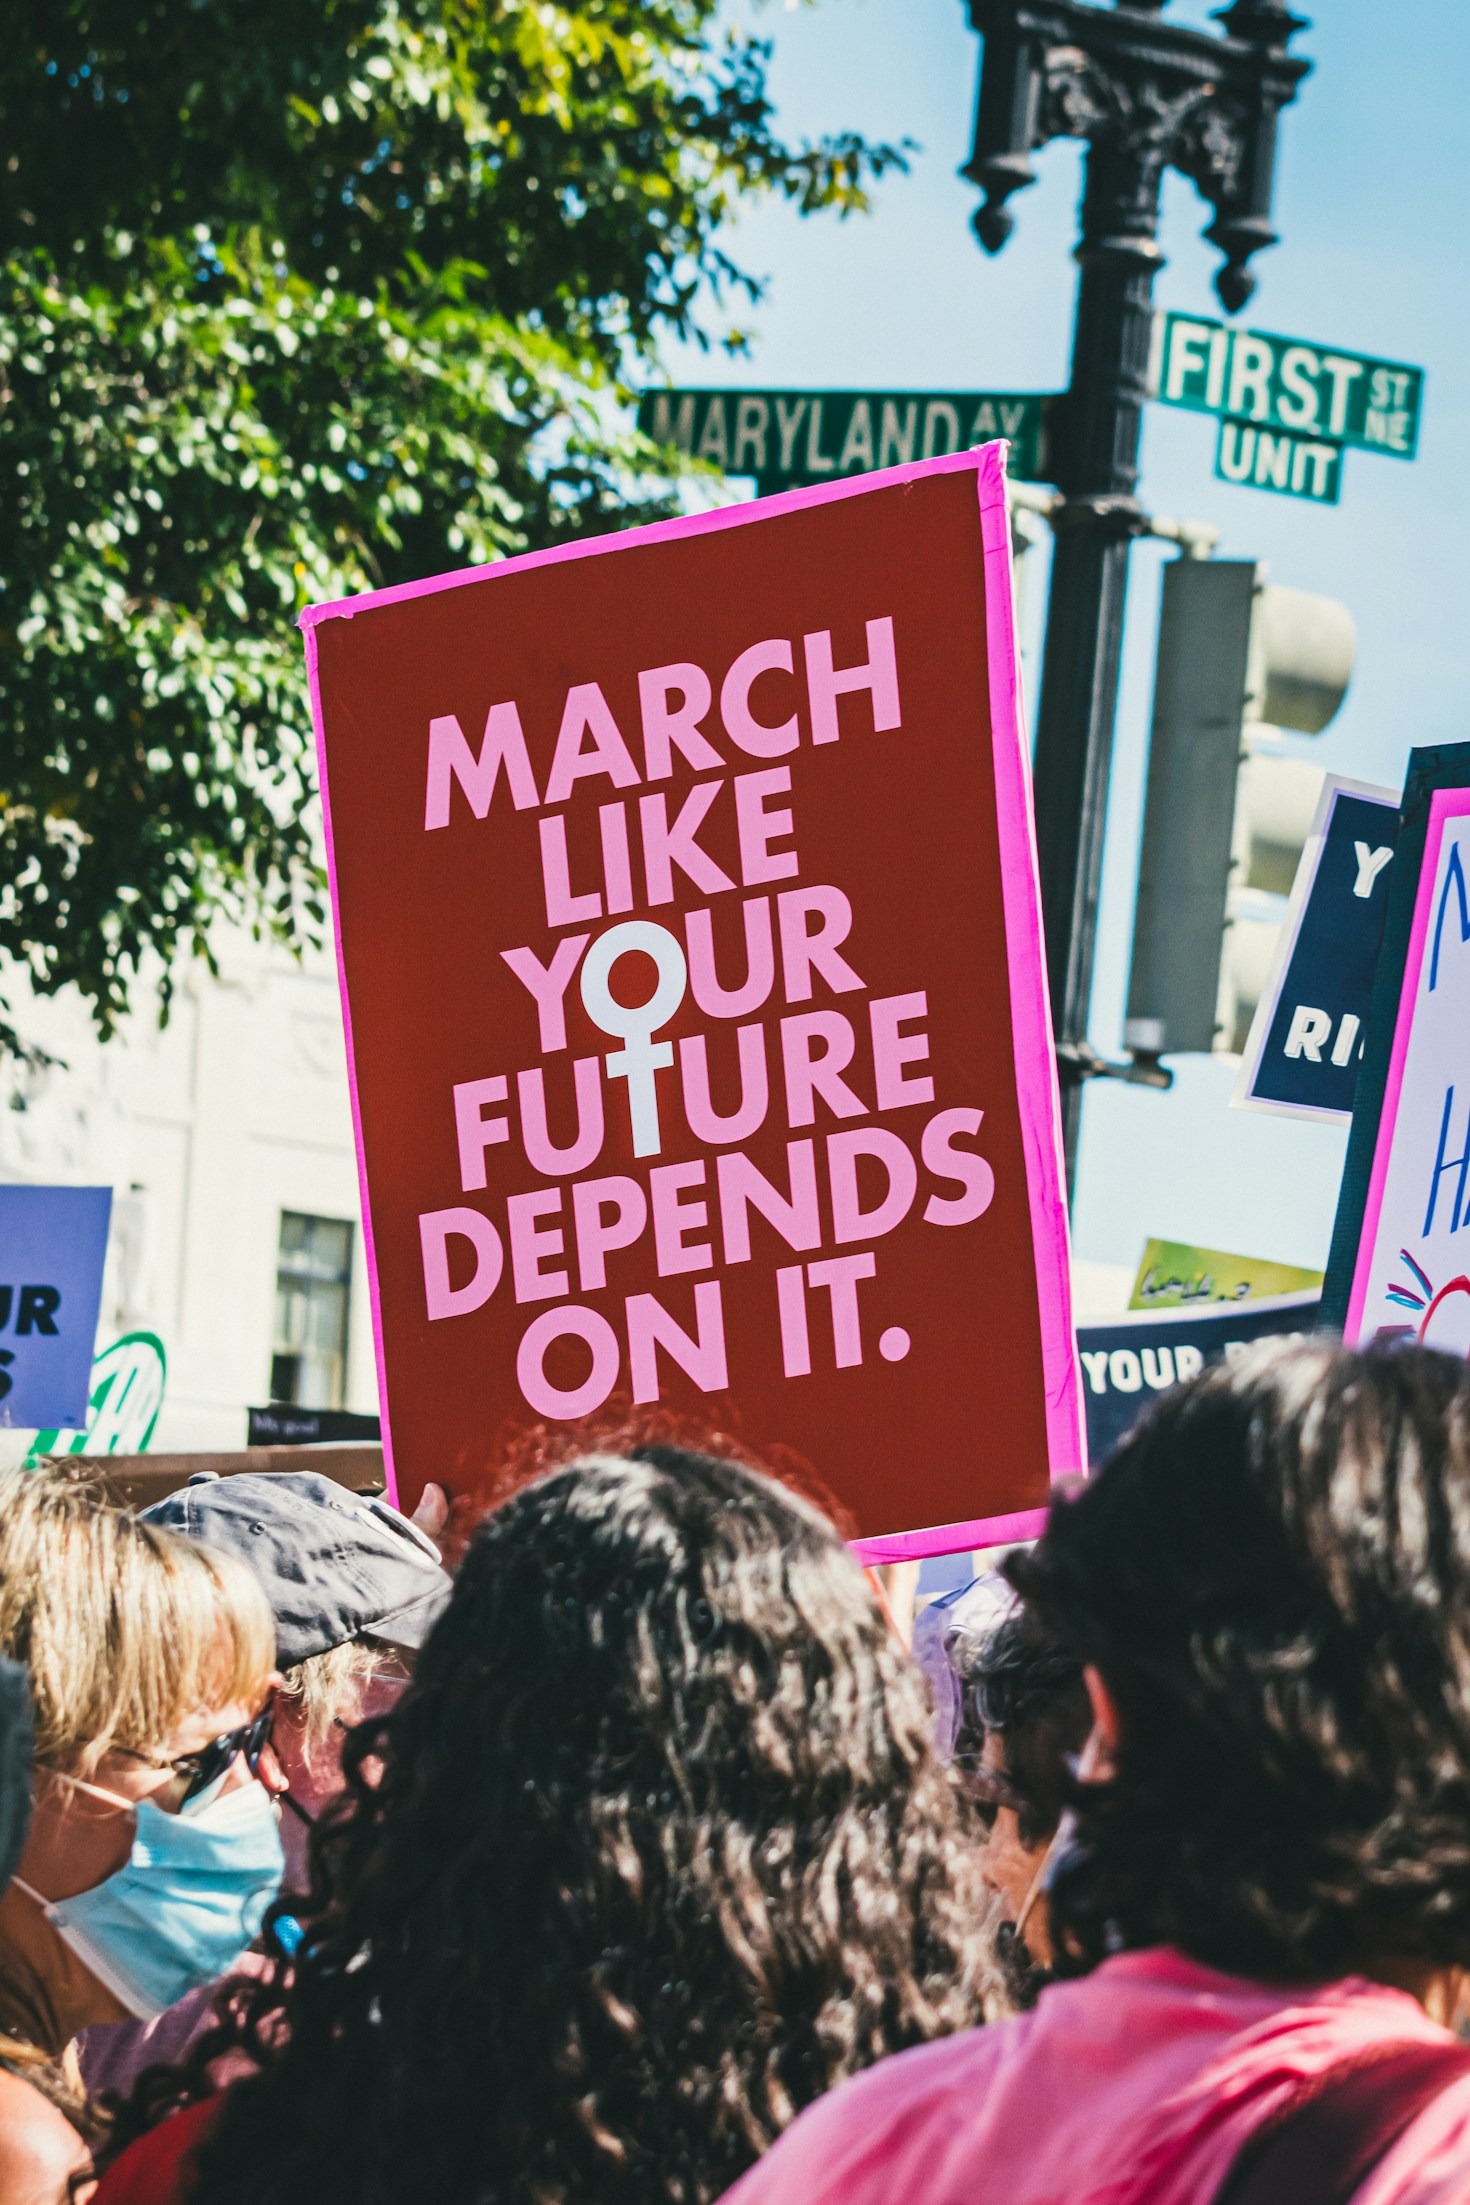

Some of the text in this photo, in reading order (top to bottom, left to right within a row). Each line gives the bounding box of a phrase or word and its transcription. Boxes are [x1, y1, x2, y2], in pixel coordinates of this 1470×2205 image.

[652, 394, 960, 472] MARYLAND
[1166, 320, 1410, 435] FIRST ST
[1364, 408, 1409, 452] NE
[1220, 422, 1338, 497] UNIT
[425, 616, 902, 831] MARCH
[539, 766, 799, 928] LIKE
[500, 885, 868, 1054] YOUR
[1283, 1005, 1365, 1068] RI
[453, 991, 935, 1192] FUTURE
[419, 1108, 995, 1322] DEPENDS
[517, 1252, 911, 1421] ON IT.
